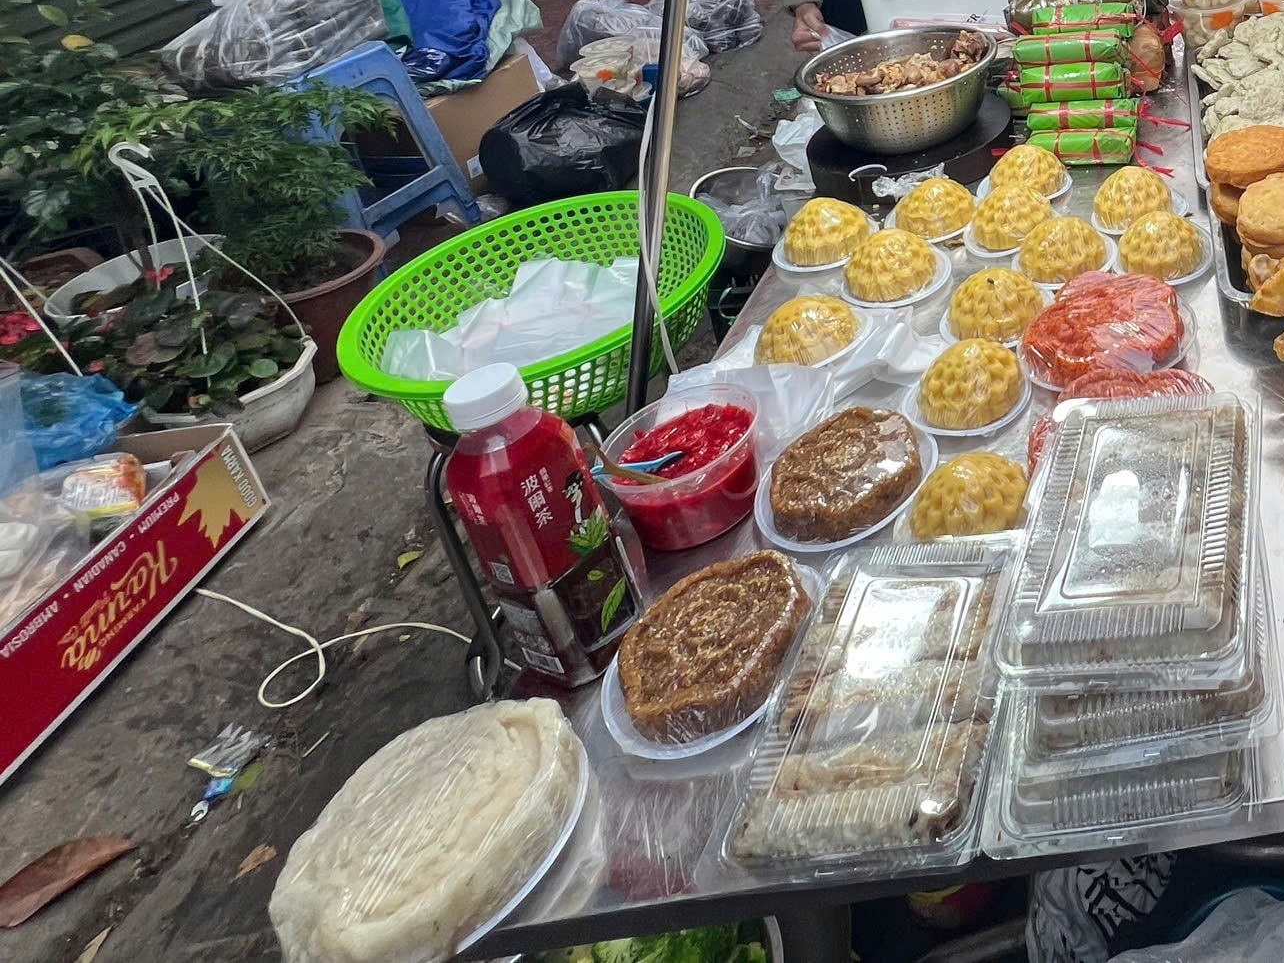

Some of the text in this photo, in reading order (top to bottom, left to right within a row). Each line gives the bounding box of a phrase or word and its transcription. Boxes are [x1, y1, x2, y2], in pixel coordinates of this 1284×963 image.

[239, 478, 258, 508] GOOD
[0, 491, 181, 659] PREMIUM CANADIAN AMBROSIA
[61, 539, 178, 669] Karma
